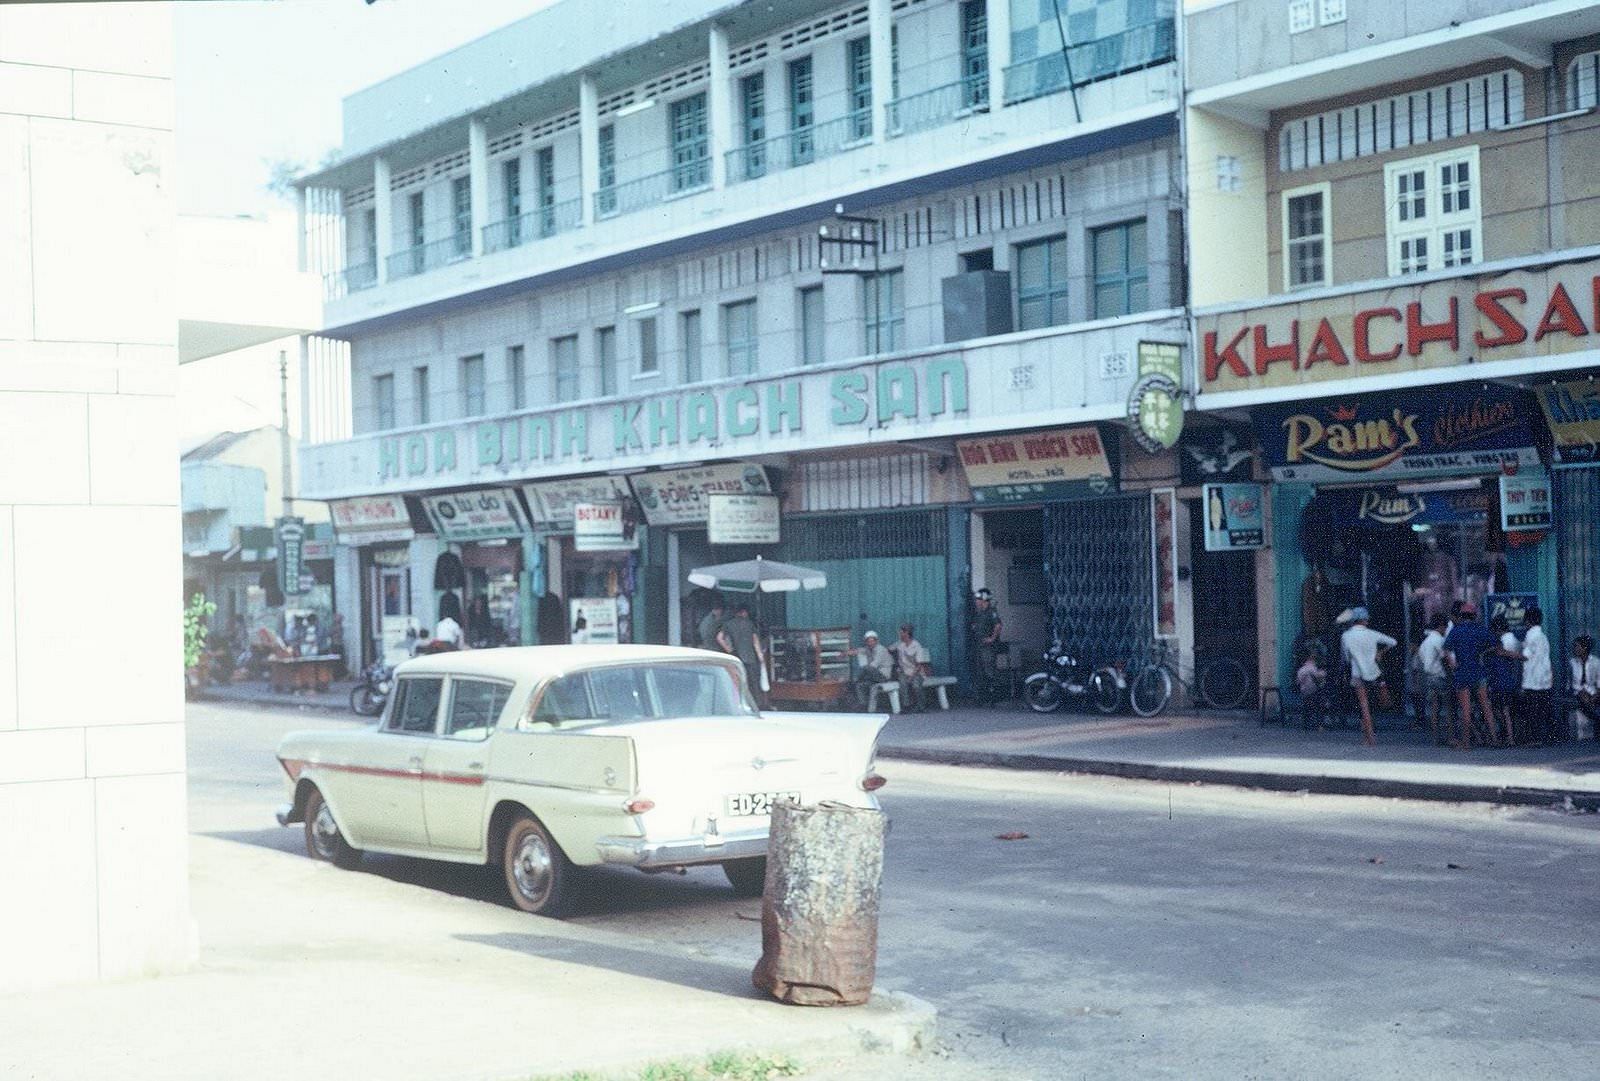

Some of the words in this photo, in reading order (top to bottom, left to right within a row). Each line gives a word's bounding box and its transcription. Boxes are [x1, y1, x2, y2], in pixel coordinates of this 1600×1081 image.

[1204, 296, 1459, 382] KHACH
[1473, 276, 1600, 348] SA
[380, 430, 456, 478] HOA
[613, 381, 802, 449] KHACH
[830, 358, 969, 426] SAN
[1283, 409, 1422, 472] Ram's
